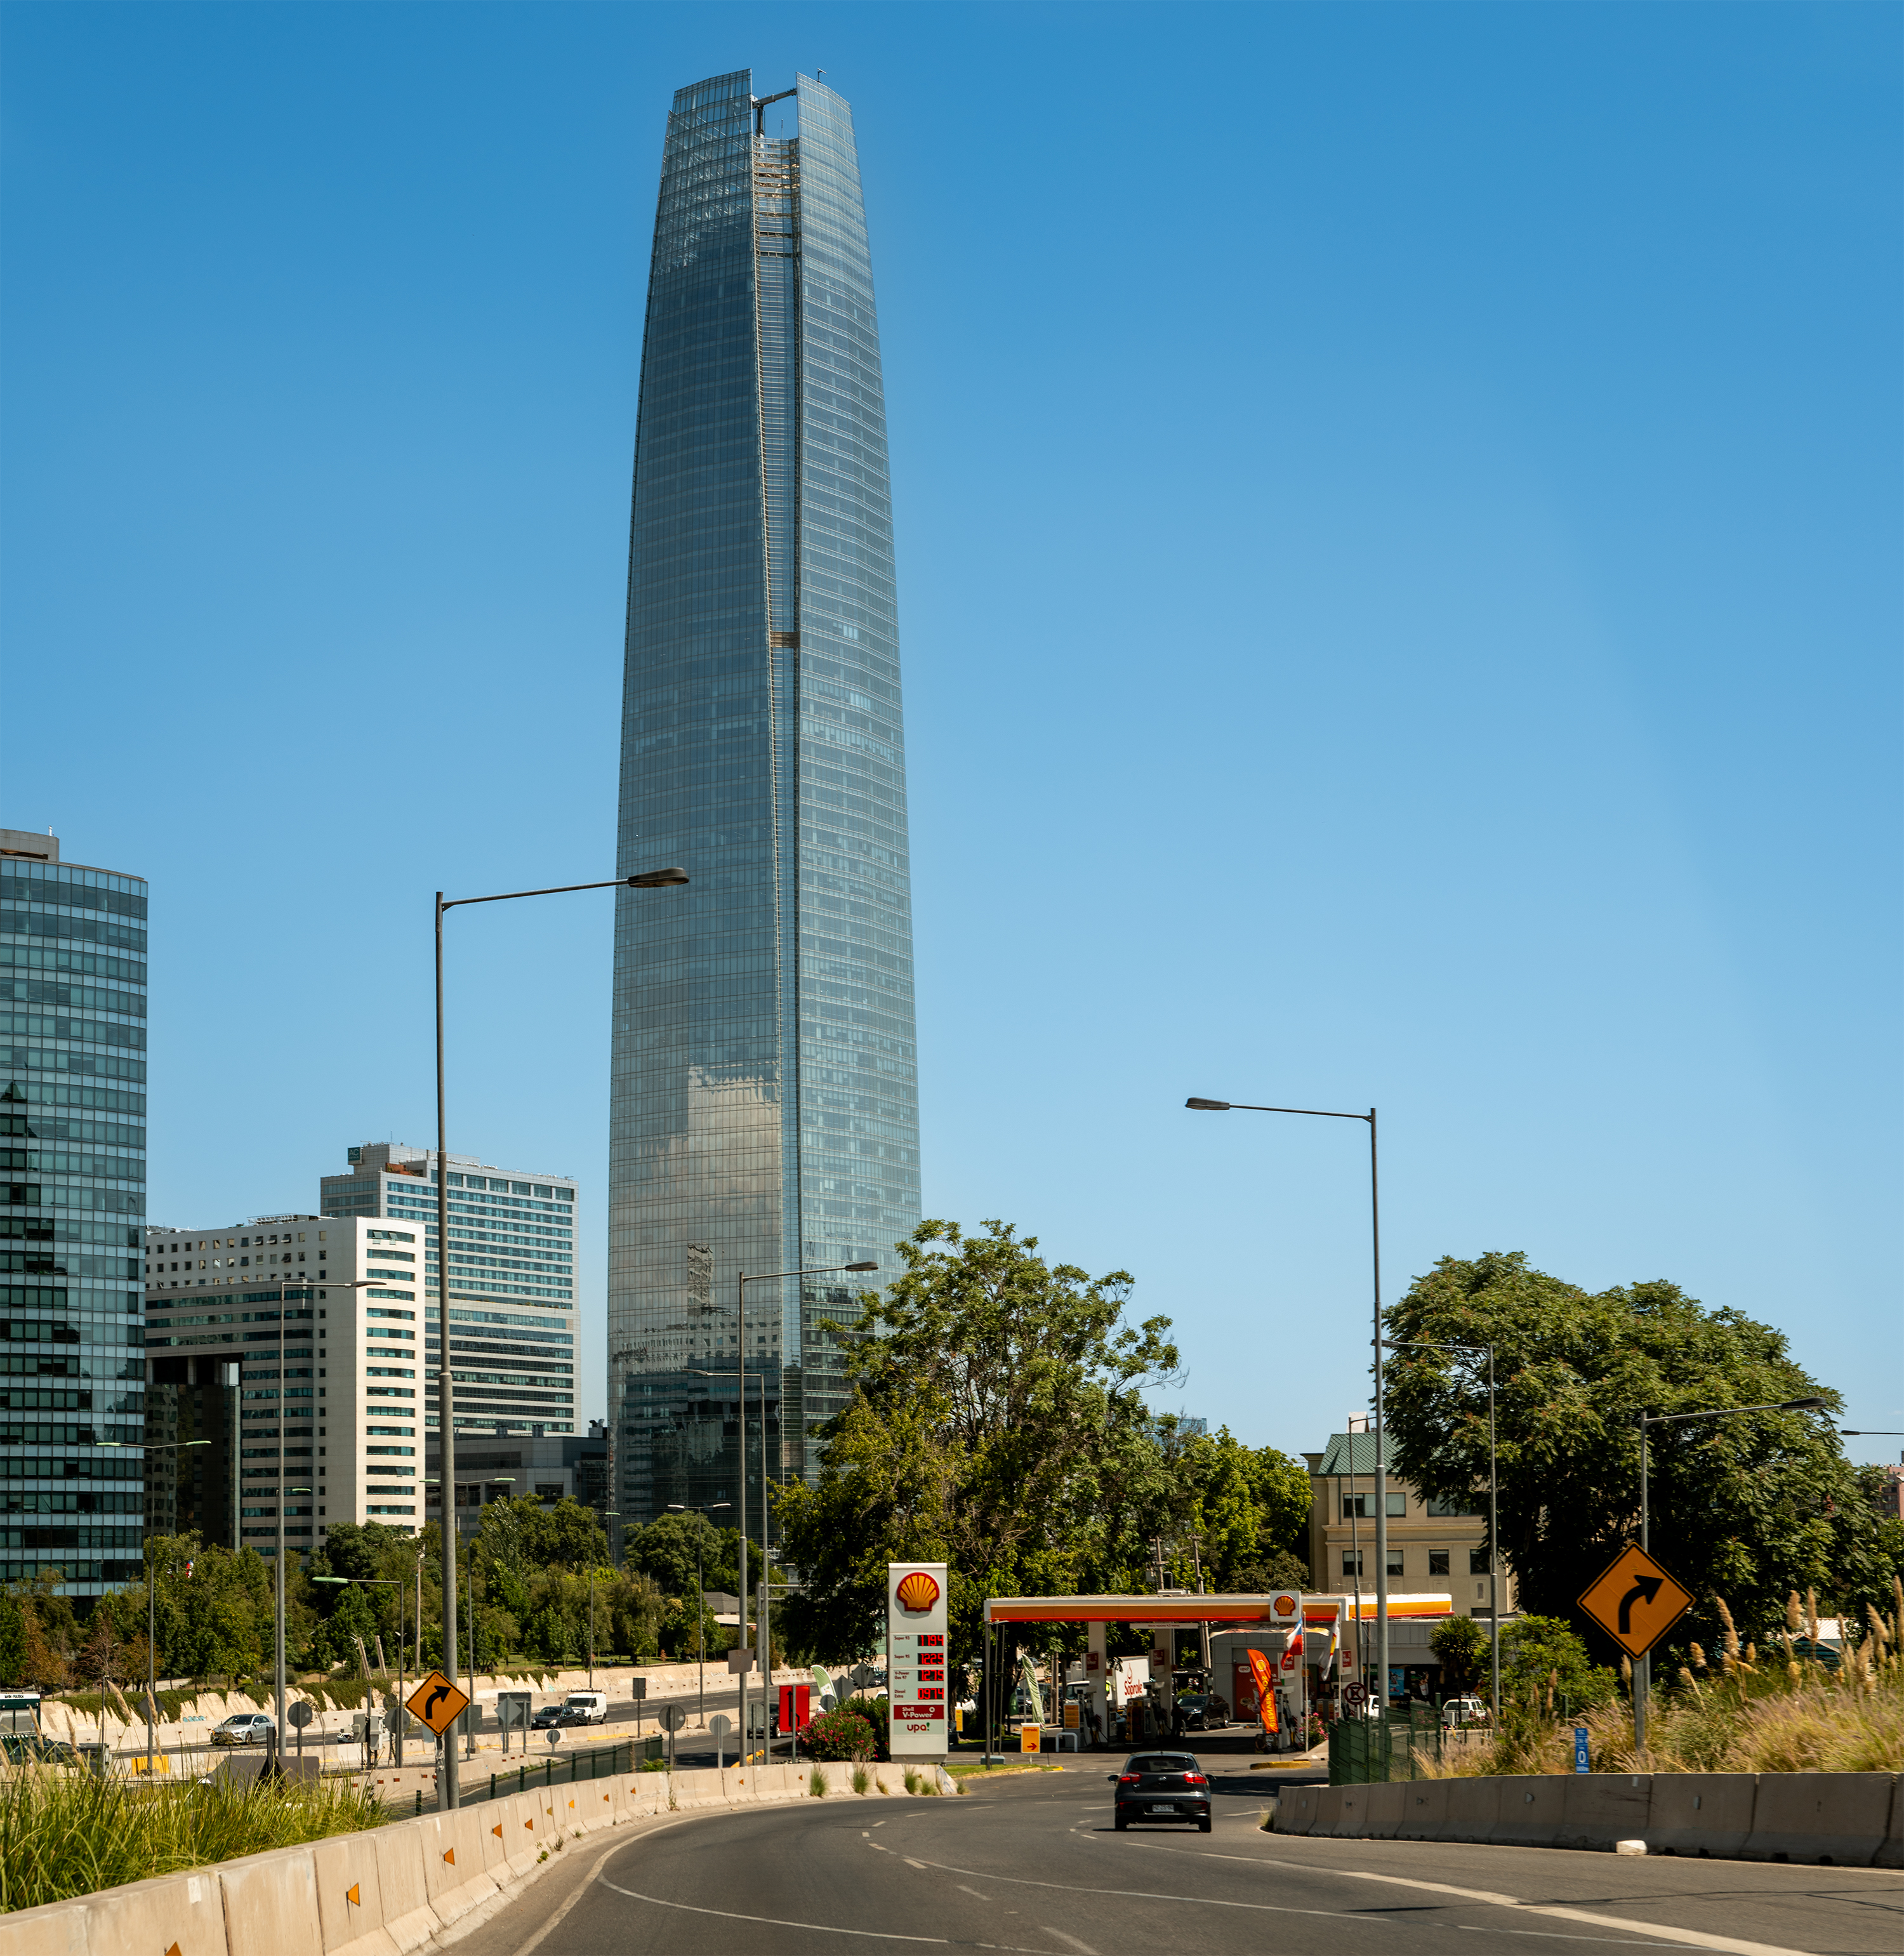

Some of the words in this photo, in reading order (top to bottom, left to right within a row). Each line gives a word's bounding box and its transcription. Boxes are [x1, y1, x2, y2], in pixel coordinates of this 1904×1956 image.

[920, 1635, 944, 1646] 1194
[920, 1653, 944, 1665] 1225
[921, 1670, 944, 1681] 1275
[918, 1688, 944, 1700] 0974
[907, 1722, 930, 1733] upa!
[1578, 1750, 1587, 1763] 0
